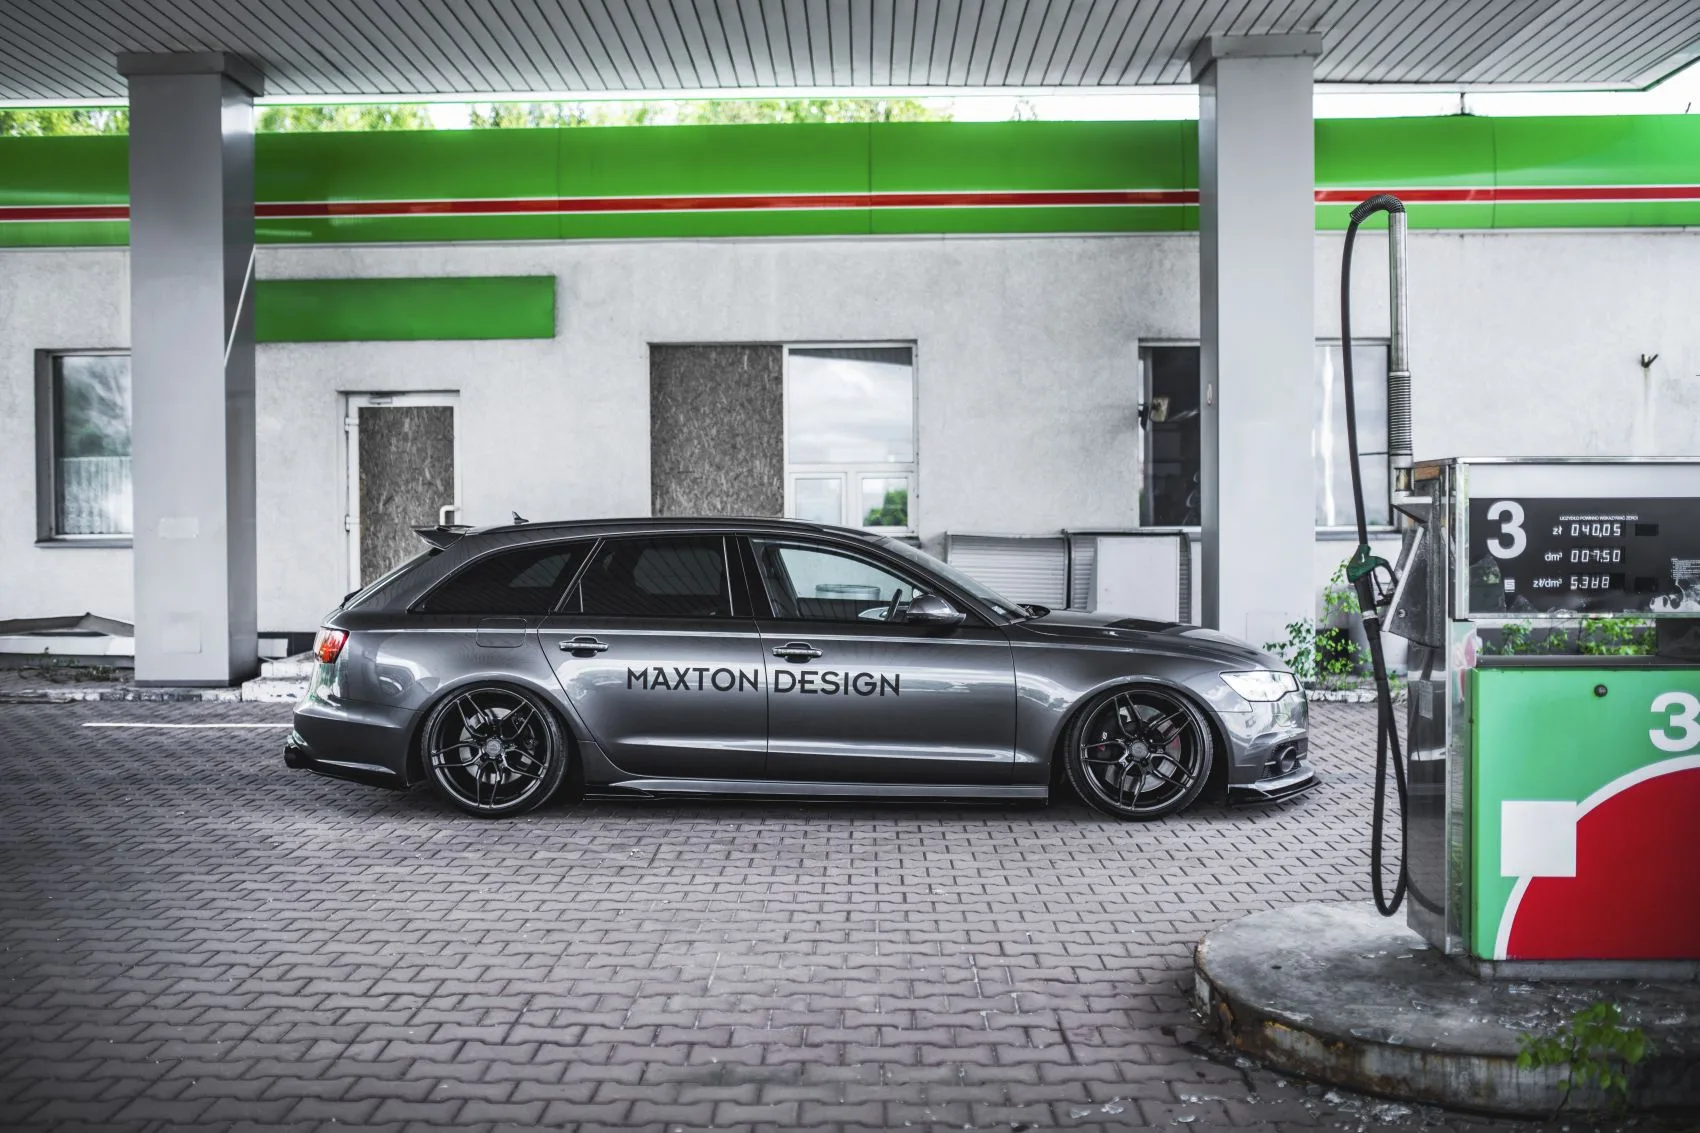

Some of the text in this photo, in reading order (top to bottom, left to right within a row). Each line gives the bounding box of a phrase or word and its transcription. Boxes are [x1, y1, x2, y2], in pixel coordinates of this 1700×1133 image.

[1487, 500, 1527, 559] 3
[1553, 525, 1562, 535] zł
[627, 667, 900, 697] MAXTON DESIGN
[1649, 692, 1700, 752] 3
